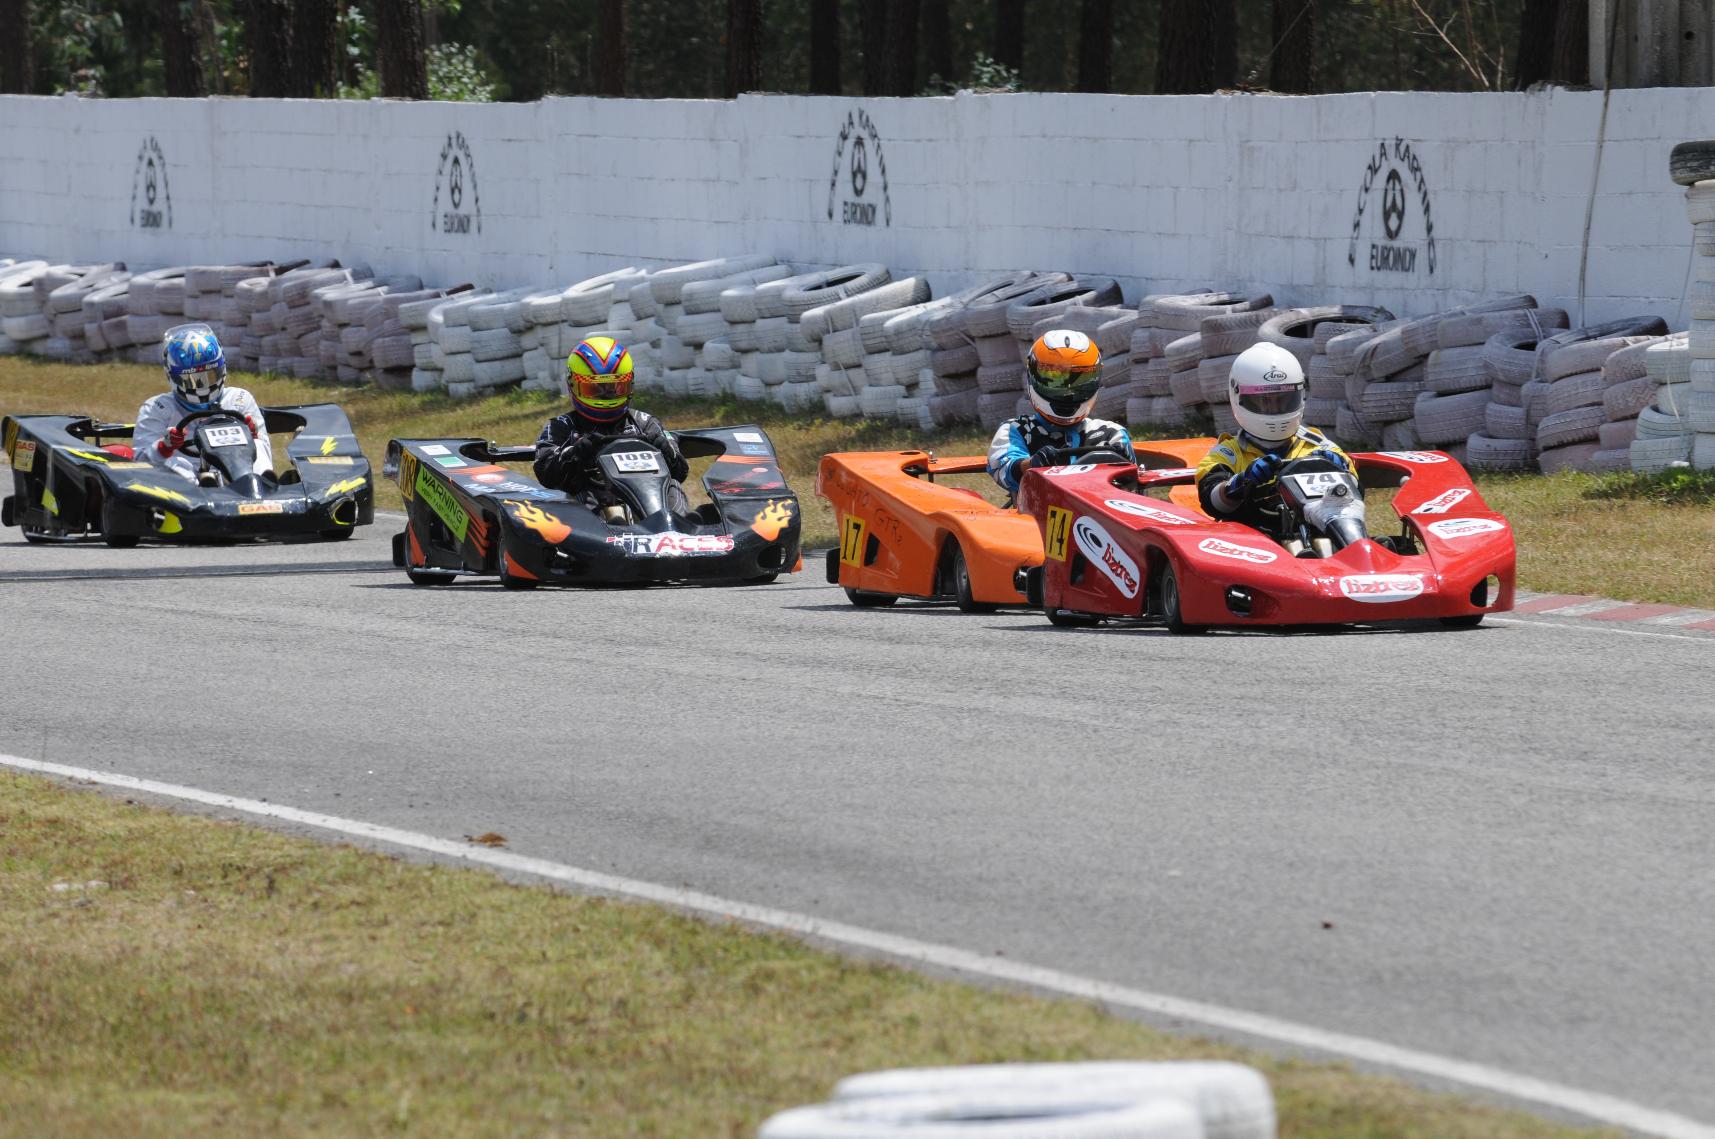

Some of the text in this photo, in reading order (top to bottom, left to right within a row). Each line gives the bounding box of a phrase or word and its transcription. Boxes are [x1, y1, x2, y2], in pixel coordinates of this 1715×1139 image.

[1395, 135, 1438, 275] KARTING
[1369, 243, 1418, 273] EUROINDY
[1267, 371, 1286, 380] Arai
[208, 427, 241, 438] 103
[15, 440, 36, 452] GAS
[1301, 473, 1337, 486] 74
[422, 467, 464, 525] WARNING
[240, 504, 282, 513] GAS
[842, 517, 862, 561] 17
[1049, 509, 1068, 558] 74
